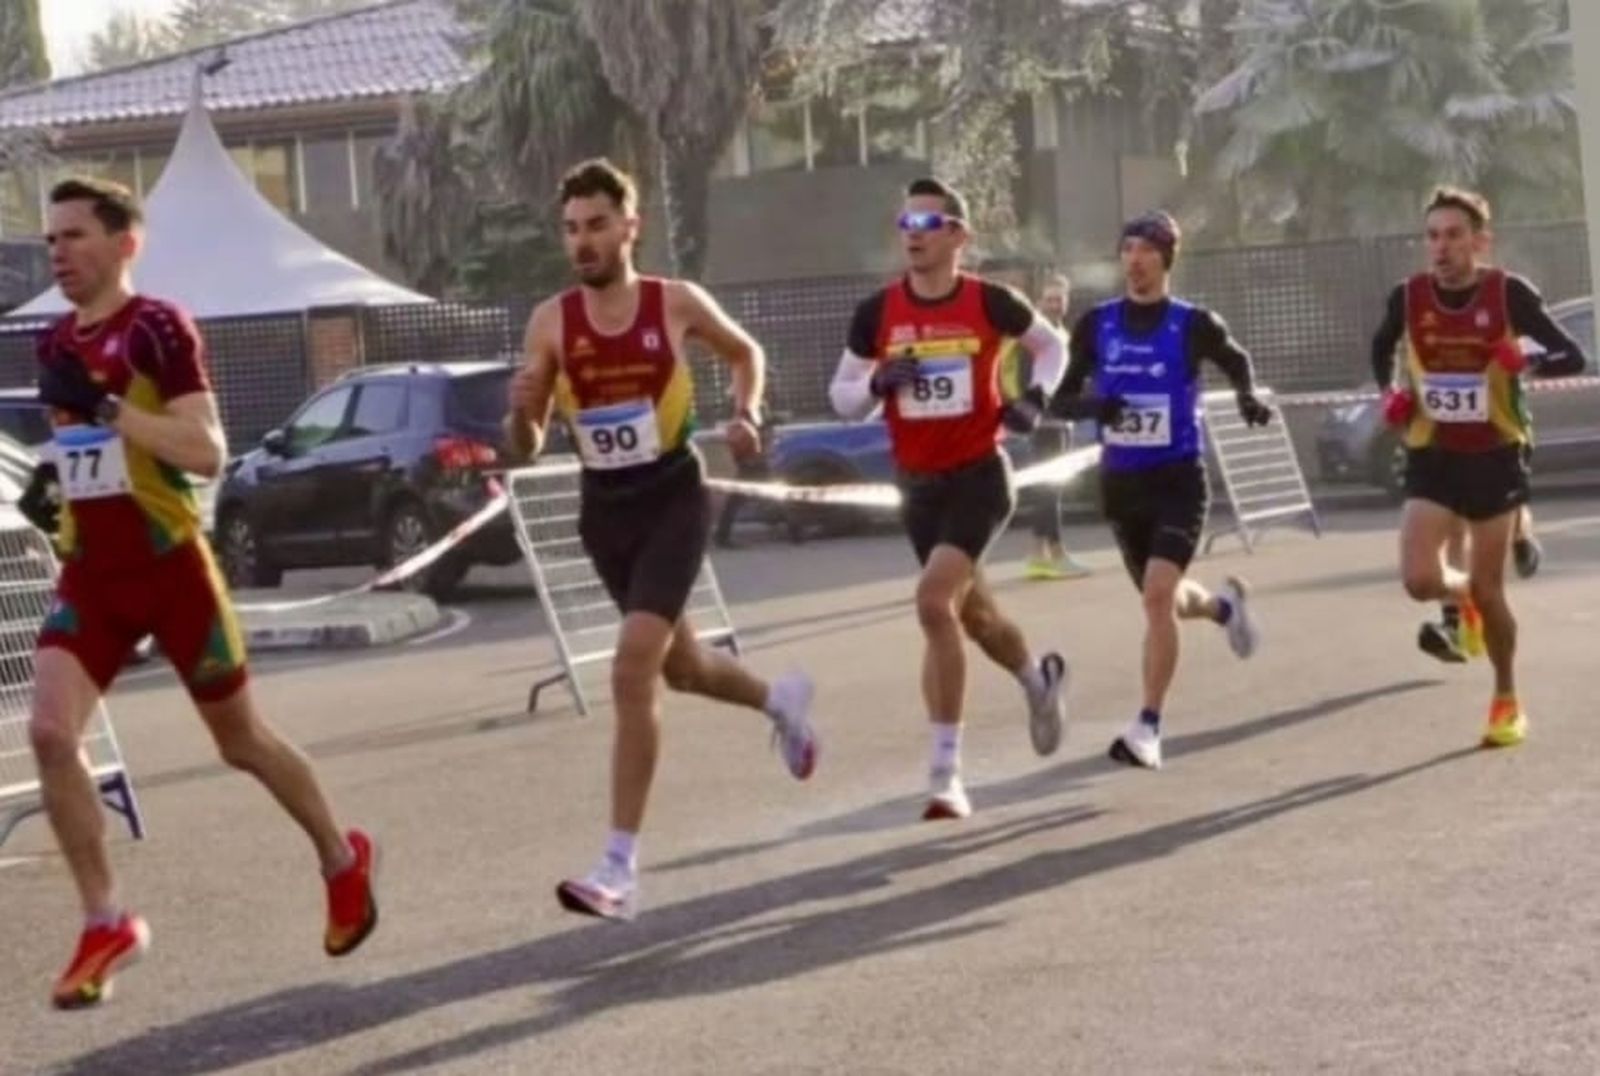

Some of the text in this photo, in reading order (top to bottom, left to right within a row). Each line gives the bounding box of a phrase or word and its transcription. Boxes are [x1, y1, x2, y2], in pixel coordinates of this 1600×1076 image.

[913, 376, 953, 402] 89
[1425, 390, 1476, 411] 631
[592, 424, 638, 454] 90
[66, 449, 102, 481] 77
